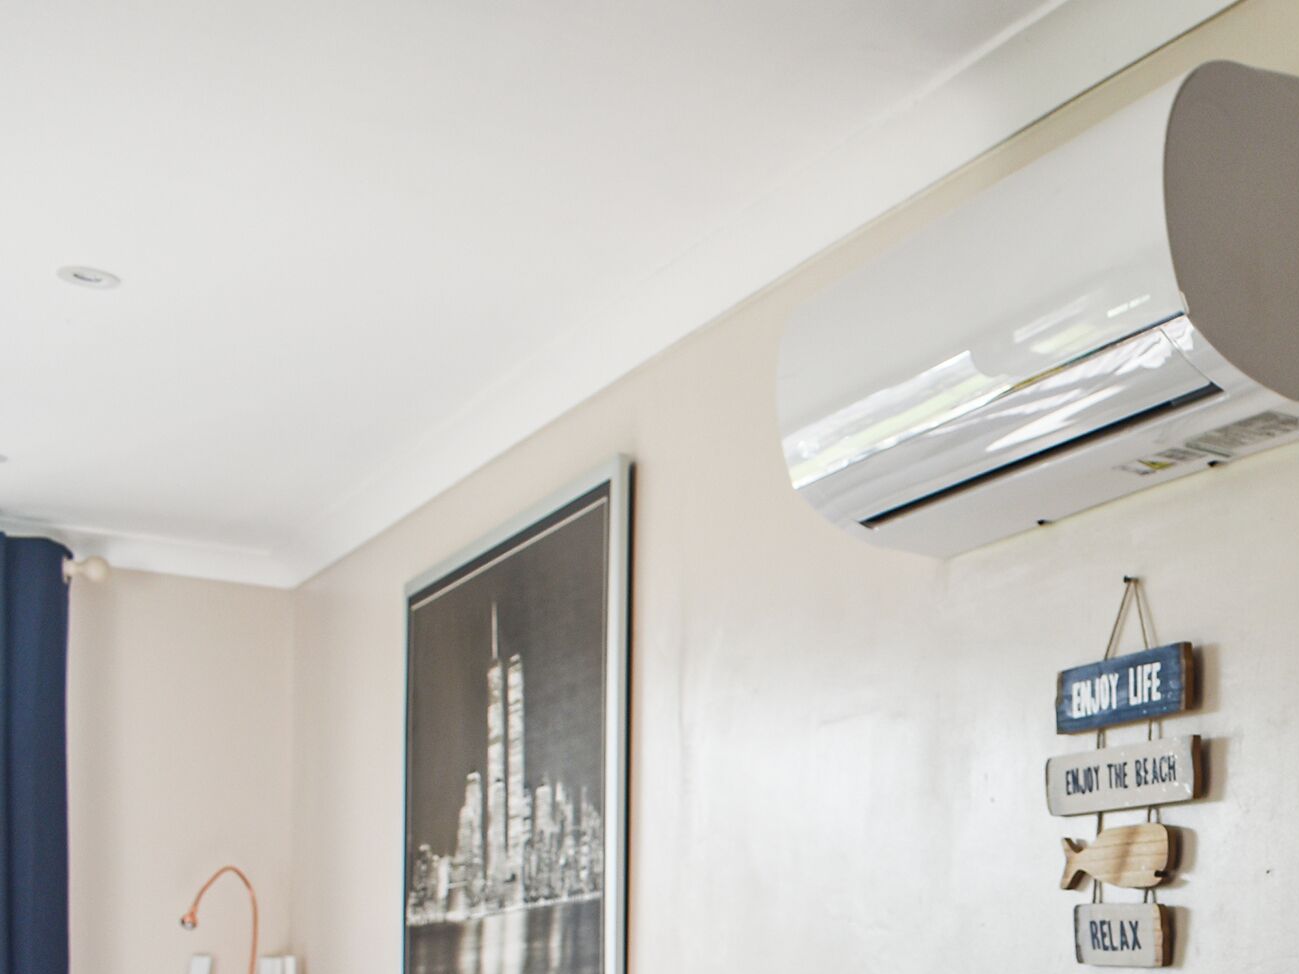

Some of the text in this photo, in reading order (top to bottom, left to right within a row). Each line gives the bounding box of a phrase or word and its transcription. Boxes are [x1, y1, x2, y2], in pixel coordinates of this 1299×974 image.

[1071, 662, 1162, 718] ENJOY LIFE
[1065, 754, 1177, 796] ENJOY THE BEACH
[1089, 919, 1142, 952] RELAX
